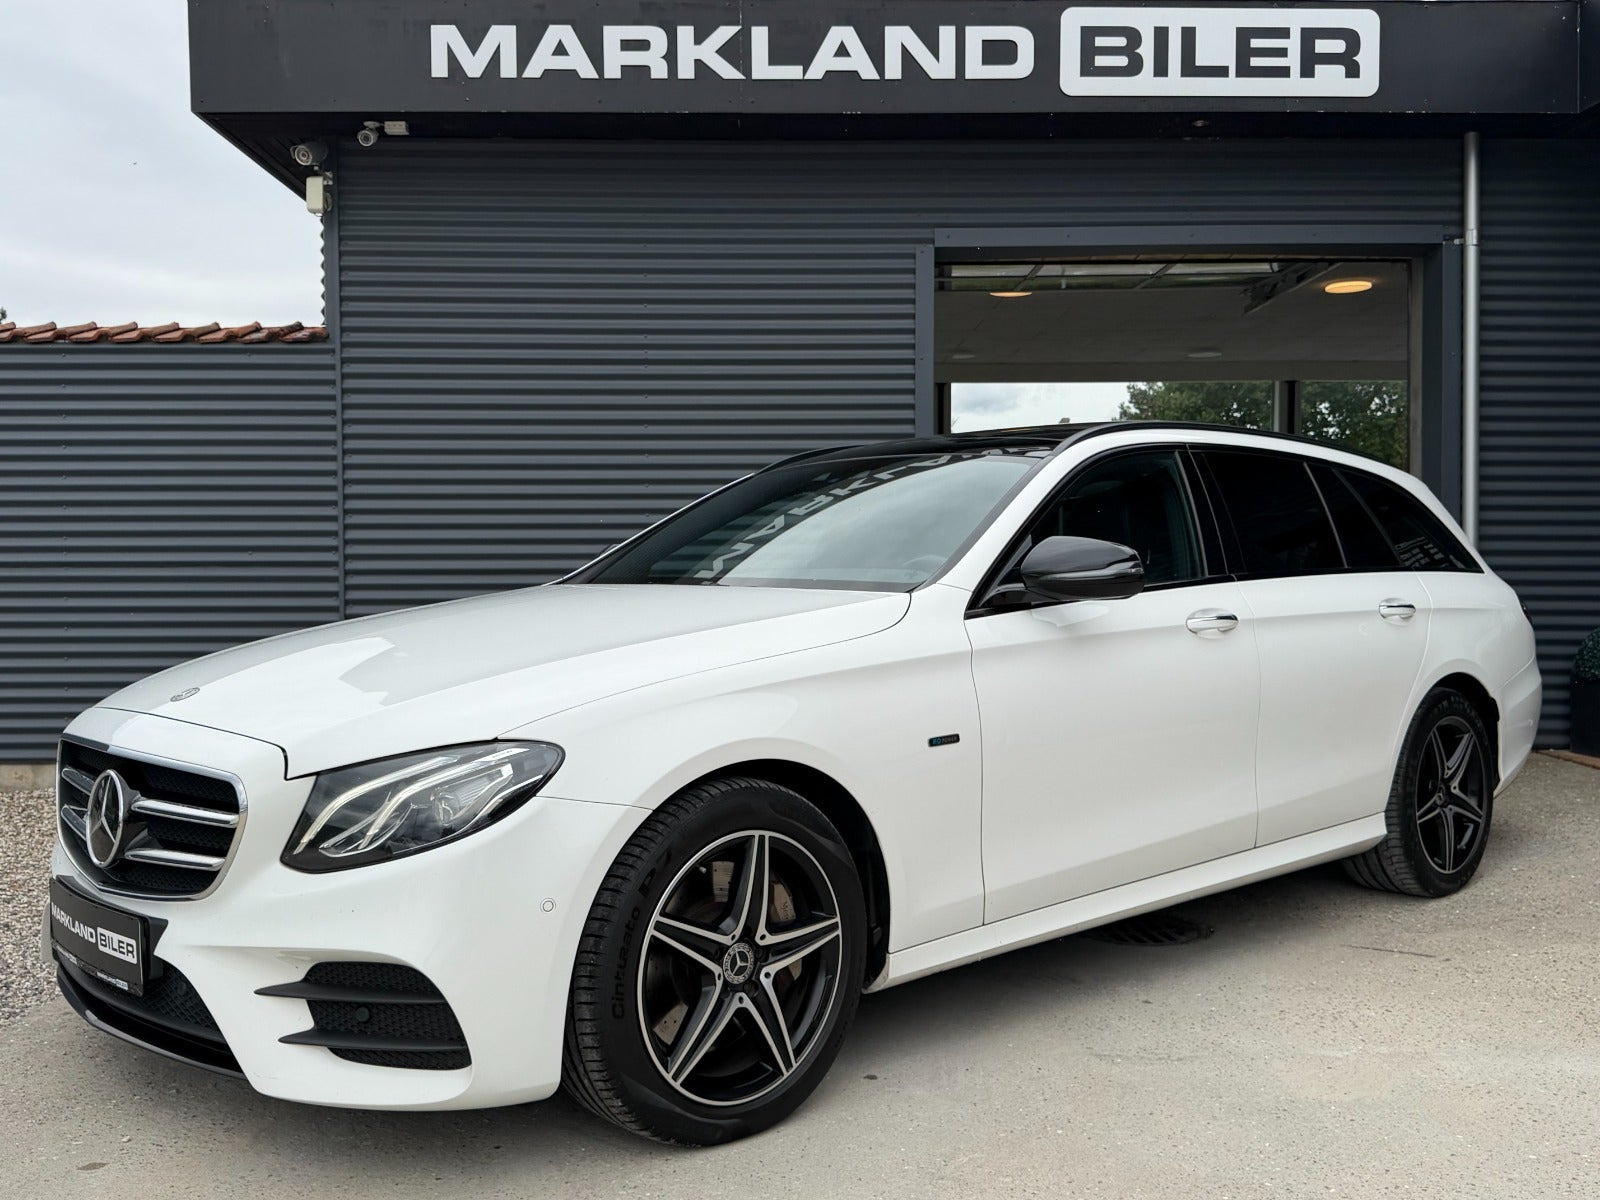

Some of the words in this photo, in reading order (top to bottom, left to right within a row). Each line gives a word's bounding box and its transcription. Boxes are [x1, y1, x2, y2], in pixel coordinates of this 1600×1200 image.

[430, 24, 1035, 80] MARKLAND
[1079, 25, 1362, 79] BILER
[51, 902, 96, 944] MARKLAND
[99, 933, 135, 959] BILER
[612, 906, 641, 1020] Cinturato
